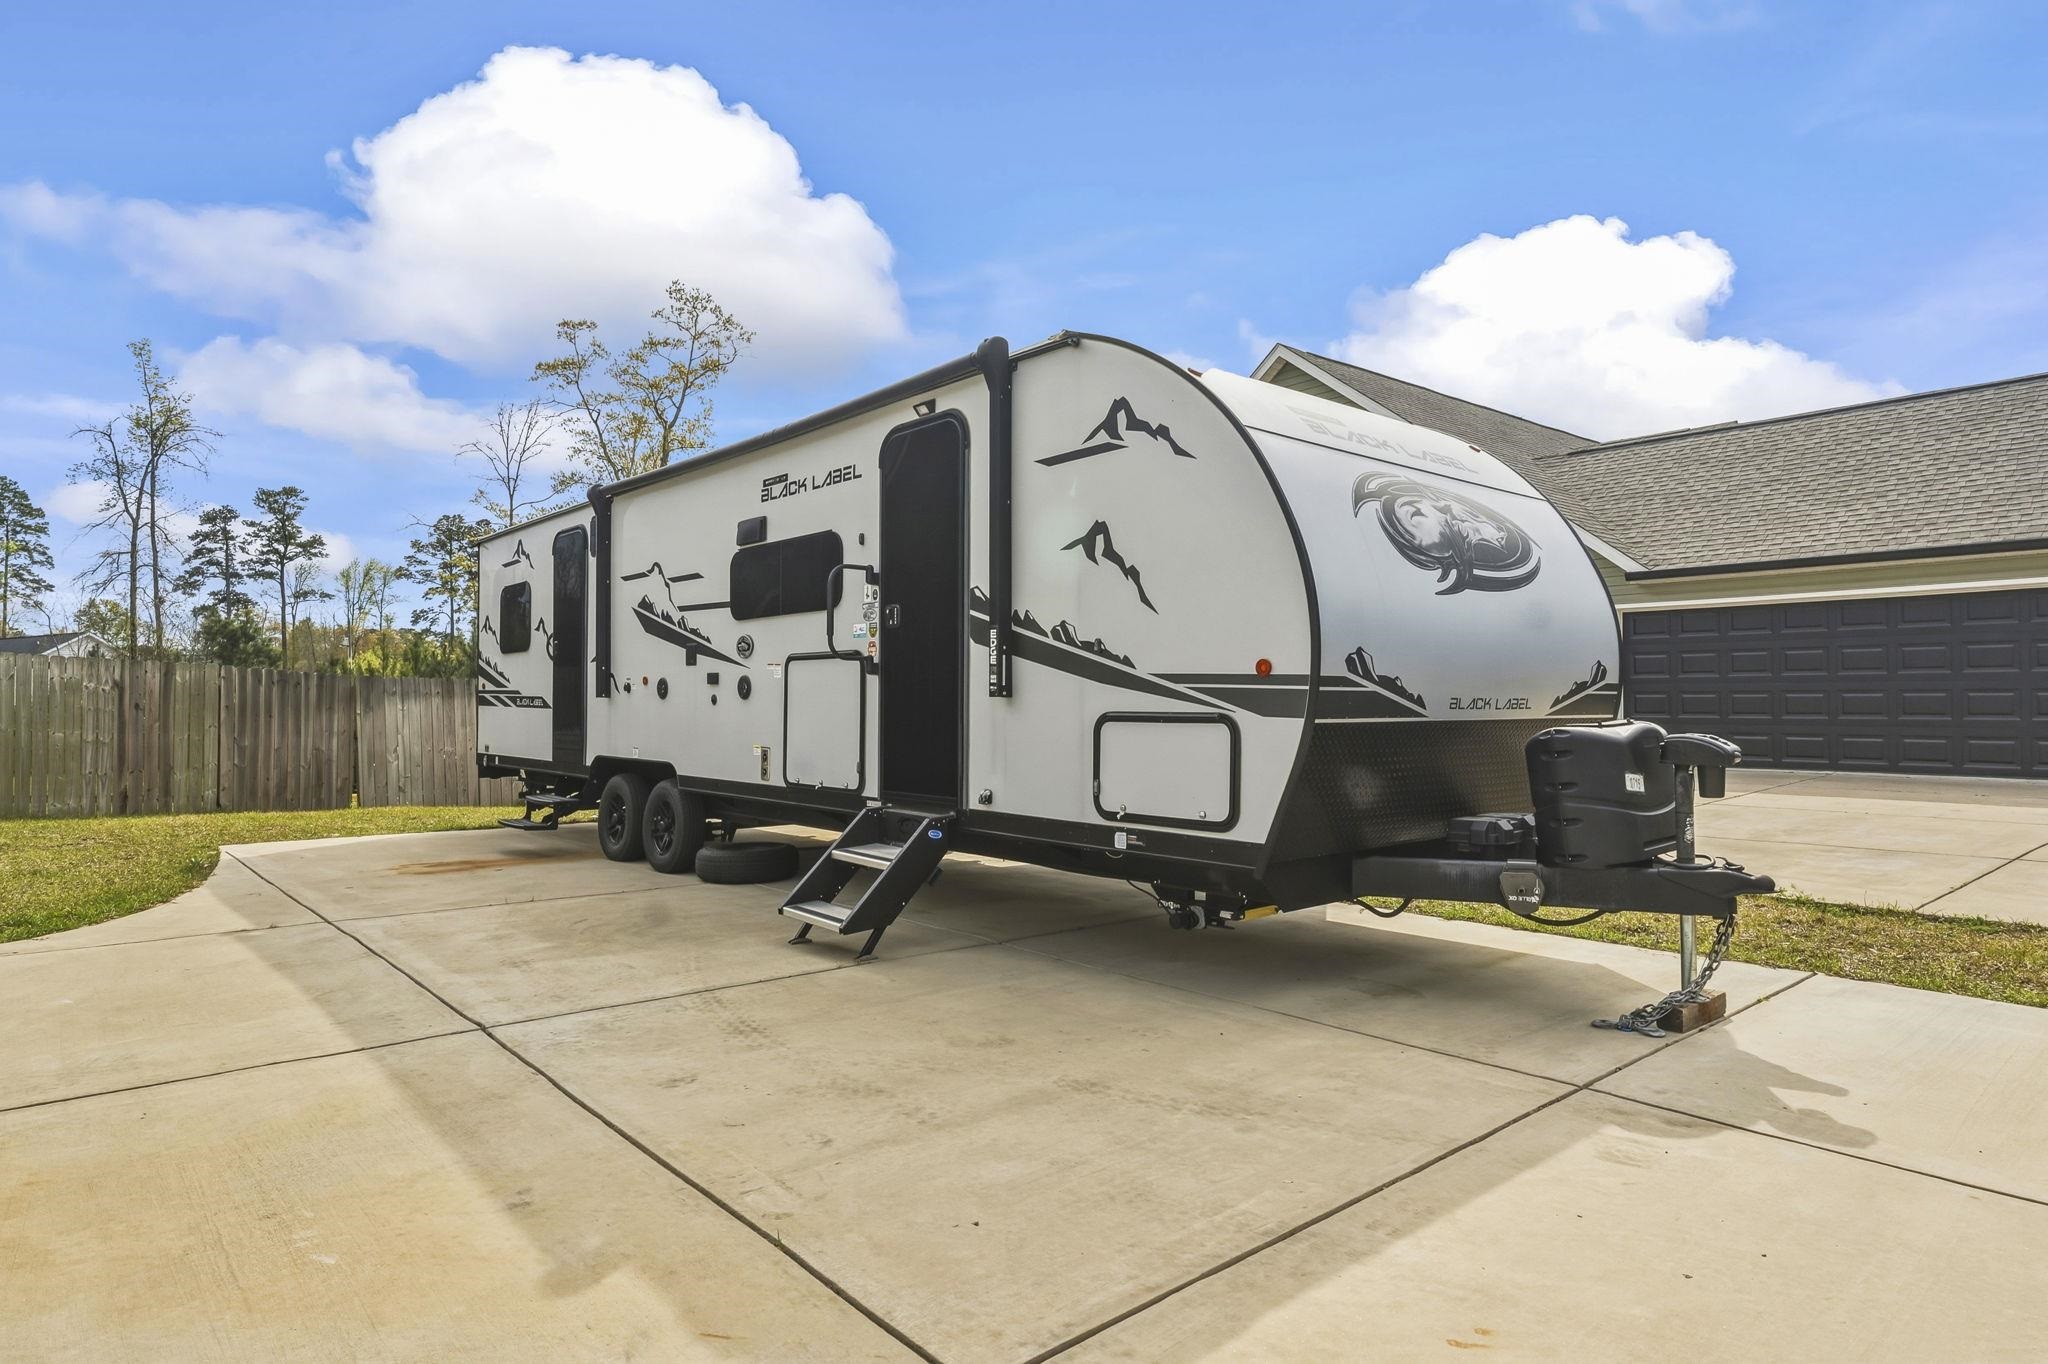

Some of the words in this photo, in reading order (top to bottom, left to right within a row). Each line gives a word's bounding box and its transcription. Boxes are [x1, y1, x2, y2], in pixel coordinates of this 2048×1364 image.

[1299, 417, 1400, 454] BLACK
[1395, 441, 1480, 475] LABEL
[760, 477, 807, 503] BLACK
[811, 464, 863, 491] LABEL
[1449, 697, 1492, 710] BLACK
[1495, 698, 1532, 710] LABEL
